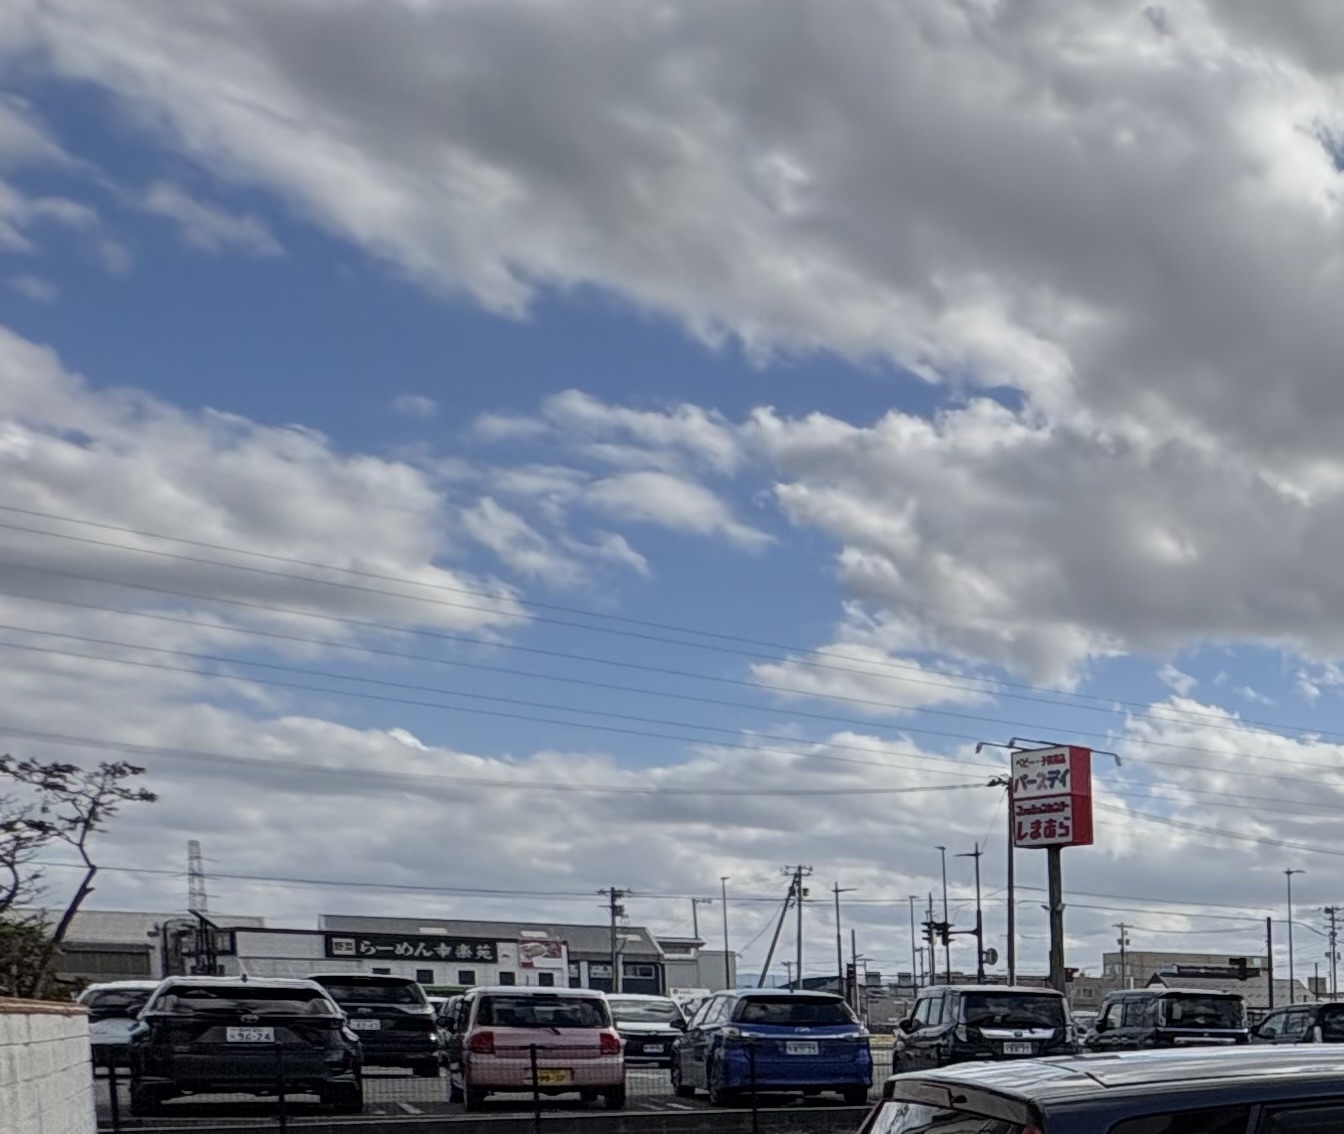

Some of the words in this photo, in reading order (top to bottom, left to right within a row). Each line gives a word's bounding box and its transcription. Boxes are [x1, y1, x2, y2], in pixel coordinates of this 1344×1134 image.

[1014, 768, 1070, 793] バースデイ
[1016, 816, 1071, 841] しまむら
[359, 940, 494, 961] らーめん幸楽苑
